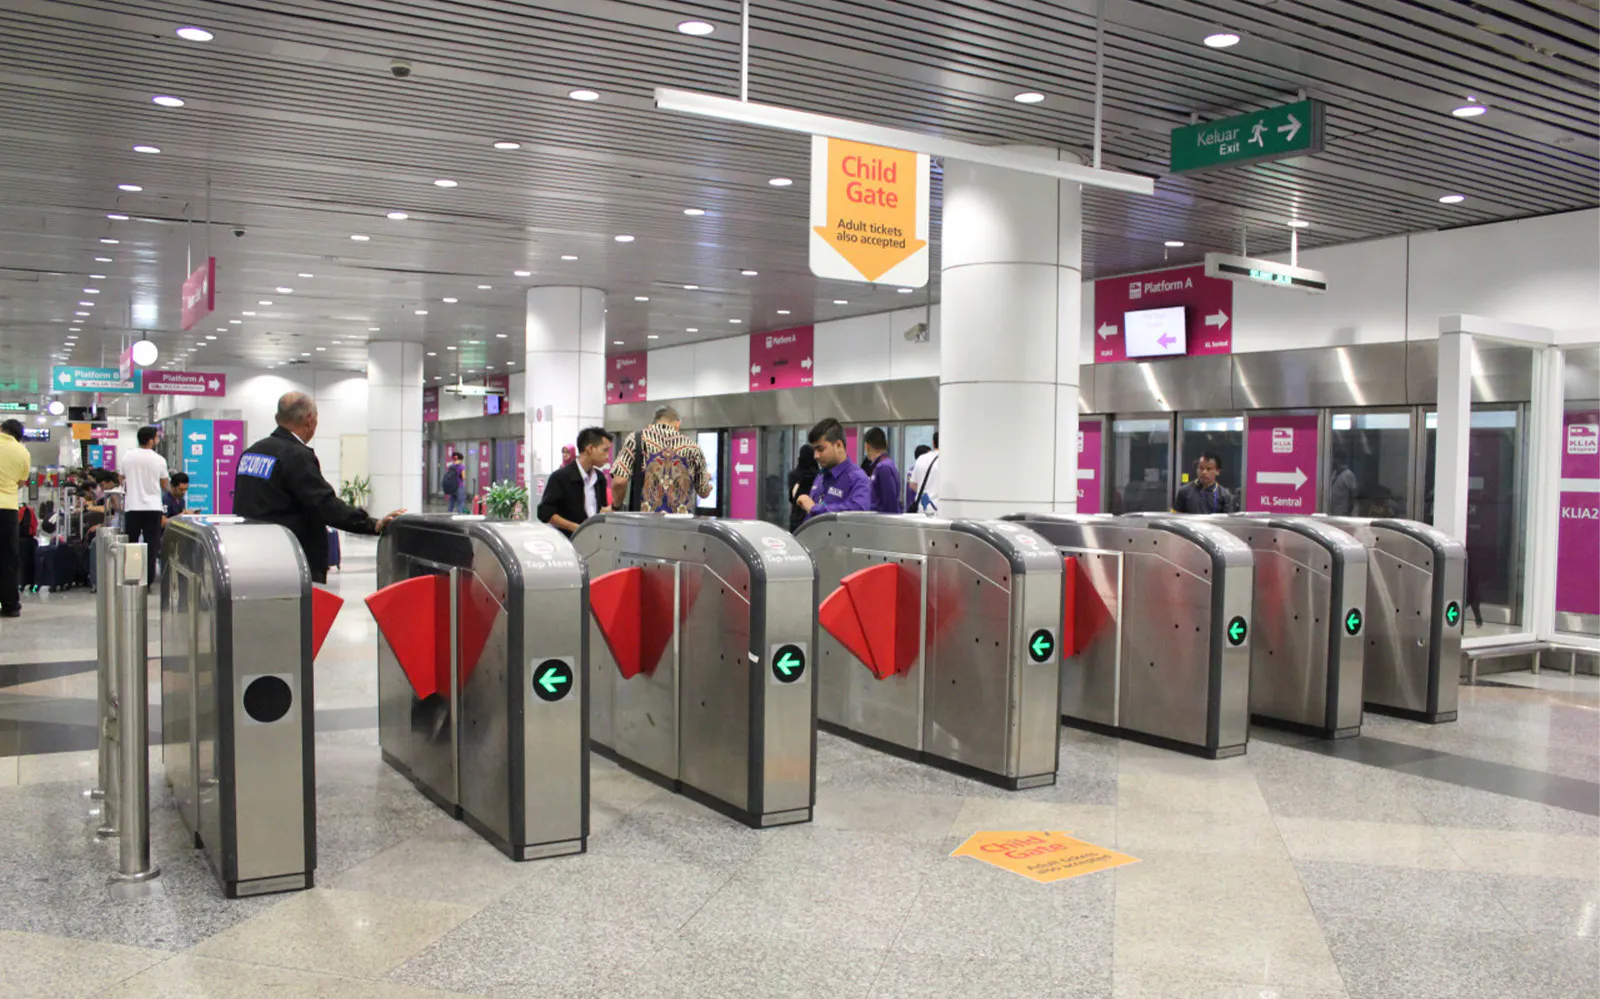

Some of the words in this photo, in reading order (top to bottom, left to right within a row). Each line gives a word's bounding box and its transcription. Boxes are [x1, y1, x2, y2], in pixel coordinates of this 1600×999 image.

[1197, 128, 1240, 147] Keluar
[1219, 142, 1240, 155] Exit
[842, 155, 897, 183] Child
[846, 181, 898, 208] Gate
[837, 219, 867, 232] Adult
[870, 223, 902, 237] tickets
[836, 231, 858, 243] also
[860, 235, 906, 249] accepted
[1144, 280, 1183, 294] Platform
[1185, 277, 1193, 288] A
[774, 336, 791, 345] Platform
[74, 370, 111, 379] Platform
[163, 374, 197, 382] Platform
[1261, 496, 1271, 506] KL
[1273, 496, 1302, 507] Sentral
[1562, 507, 1599, 519] KLIA2
[524, 560, 546, 569] Tap
[548, 560, 574, 568] Here
[980, 835, 1046, 852] Child
[1005, 844, 1064, 859] Gate
